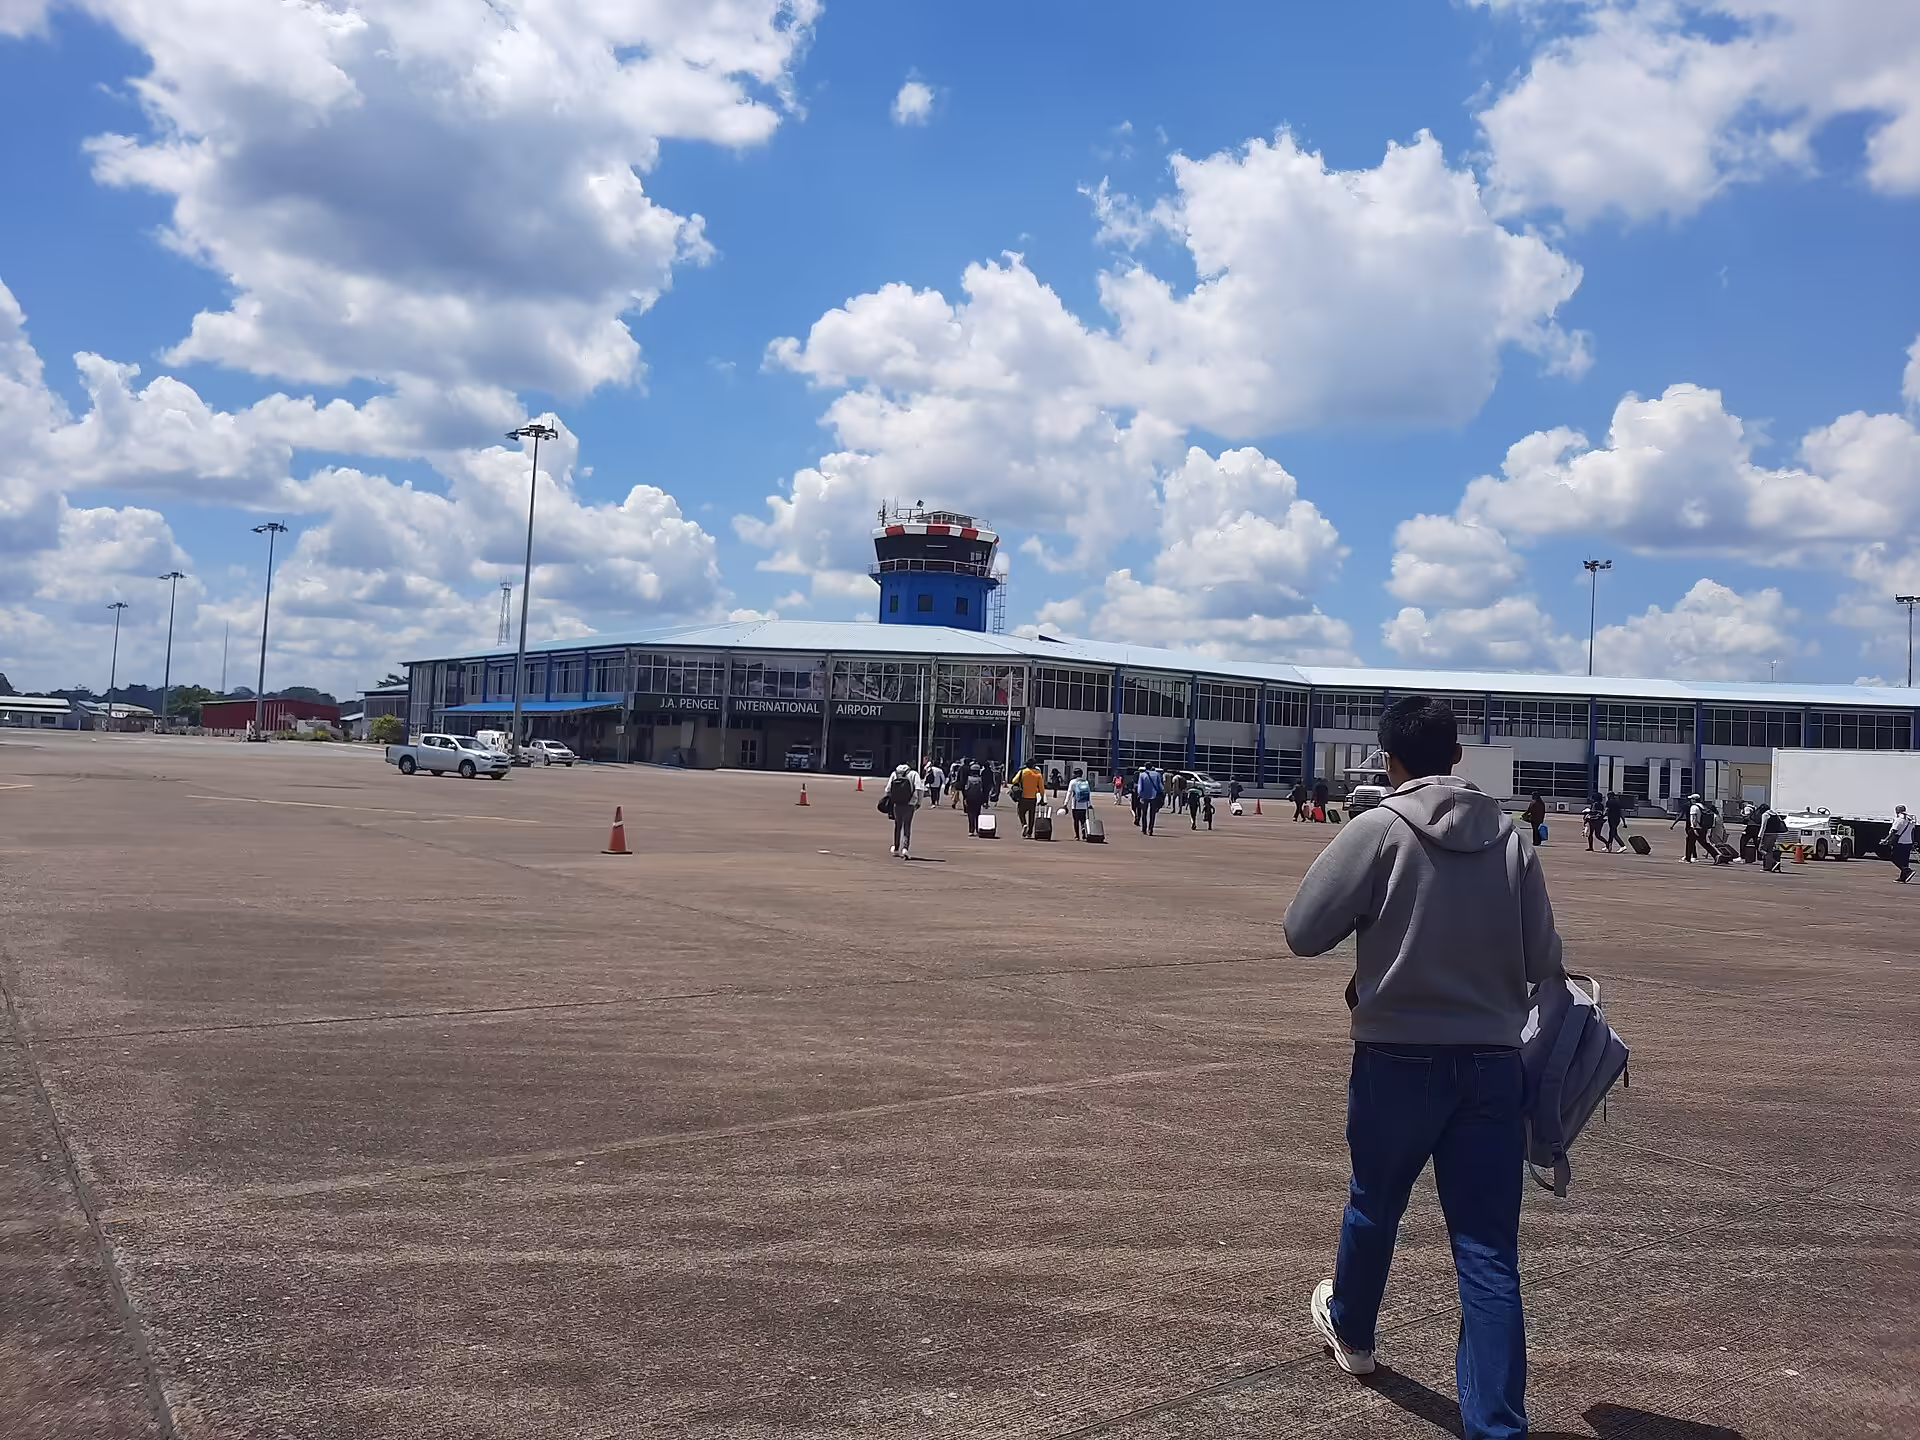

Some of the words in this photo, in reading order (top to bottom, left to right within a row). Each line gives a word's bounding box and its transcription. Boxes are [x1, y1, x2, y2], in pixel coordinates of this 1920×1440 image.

[660, 698, 677, 709] J.A.
[680, 698, 719, 710] PENGEL
[736, 700, 820, 714] INTERNATIONAL
[836, 704, 883, 716] AIRPORT
[941, 707, 975, 716] WELCOME
[976, 708, 985, 716] TO
[985, 709, 1021, 717] SURINAME
